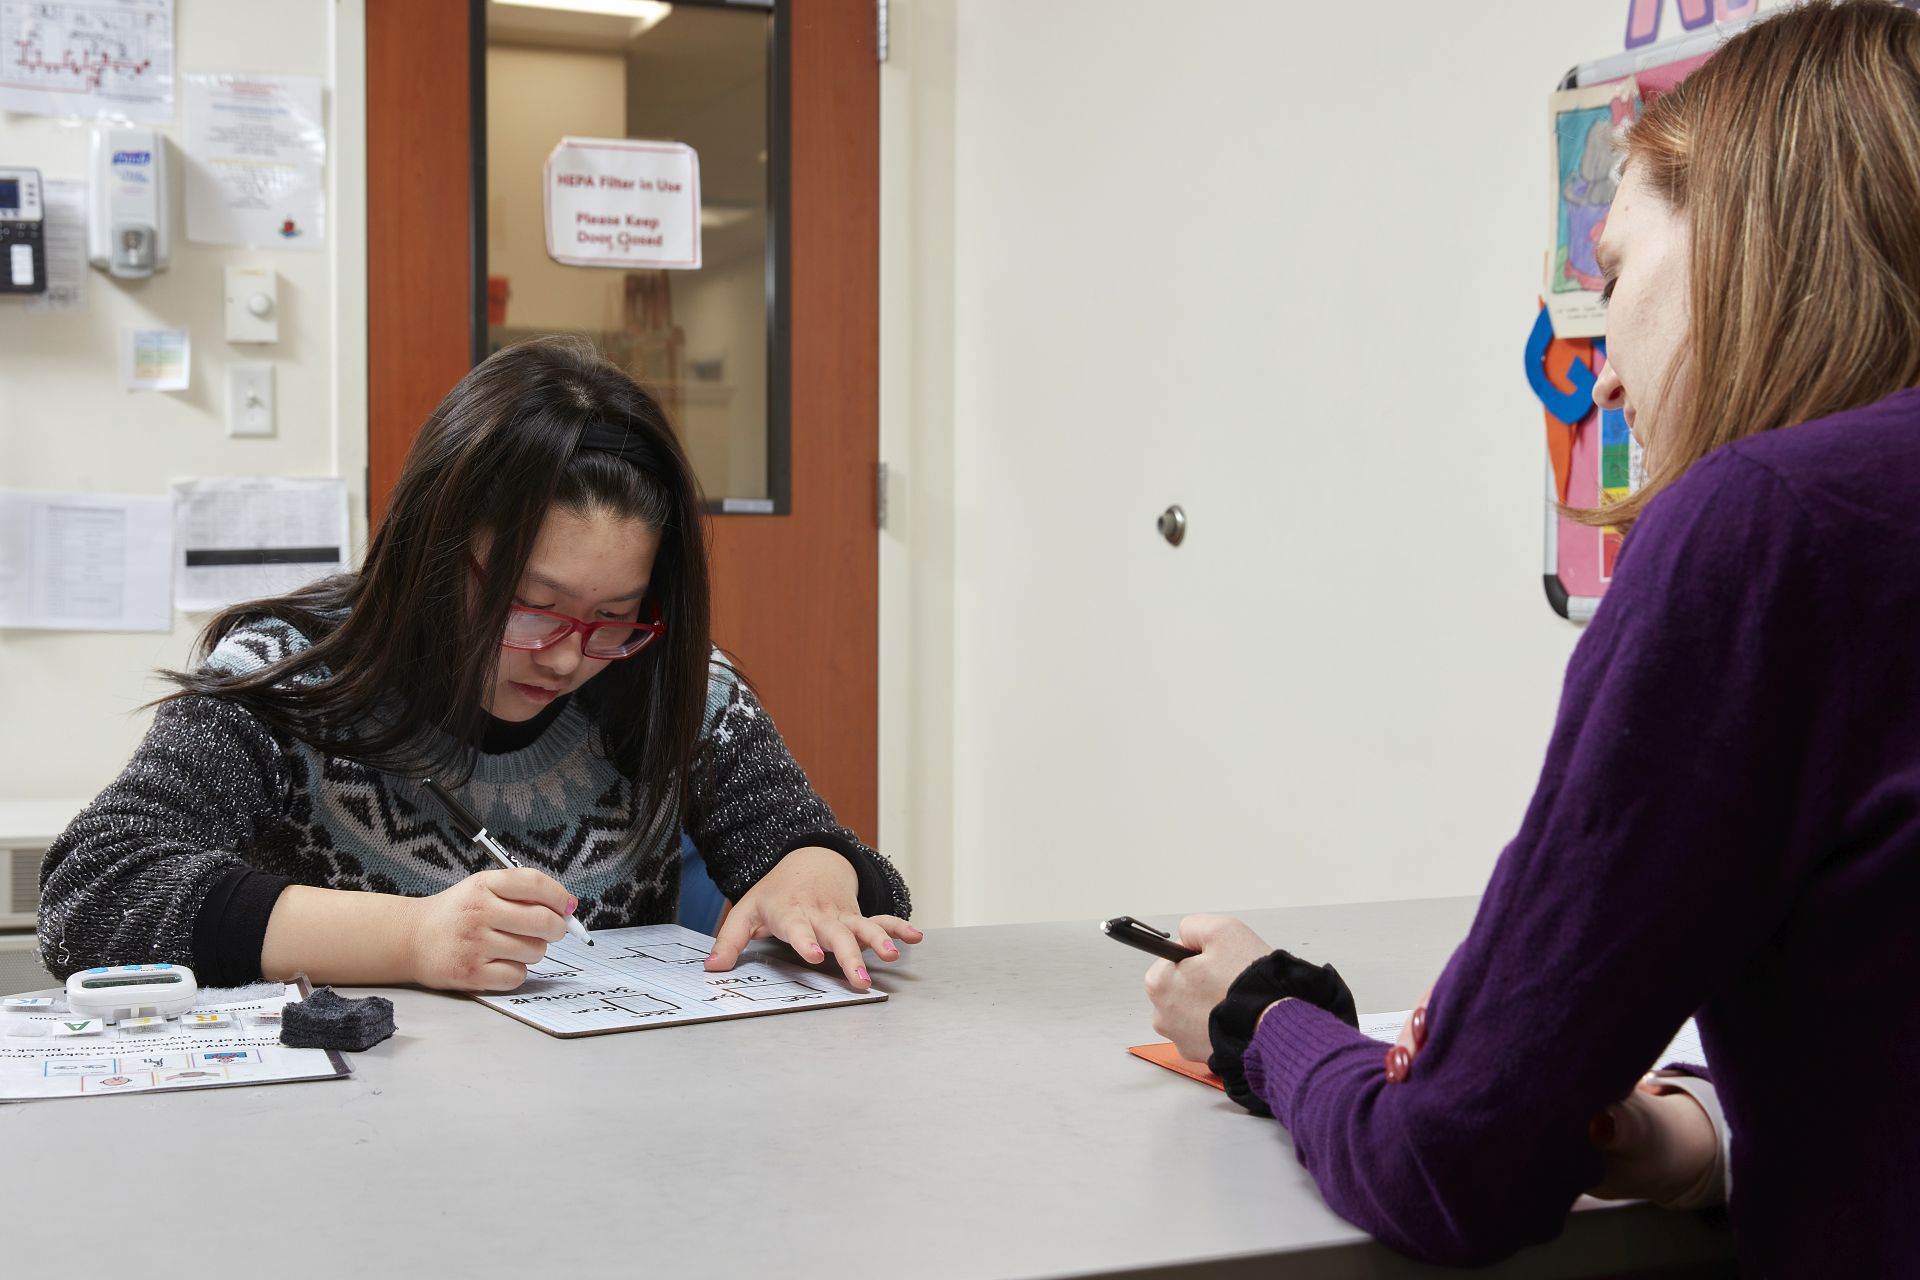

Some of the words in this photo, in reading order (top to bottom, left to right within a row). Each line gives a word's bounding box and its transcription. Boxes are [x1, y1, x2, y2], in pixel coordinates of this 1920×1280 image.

[557, 174, 593, 188] HEPA
[599, 176, 634, 191] Filter
[656, 179, 682, 193] Use
[576, 212, 620, 225] Please
[625, 214, 660, 230] Keep
[577, 231, 612, 244] Door
[617, 232, 663, 248] Closed
[63, 1020, 92, 1032] A
